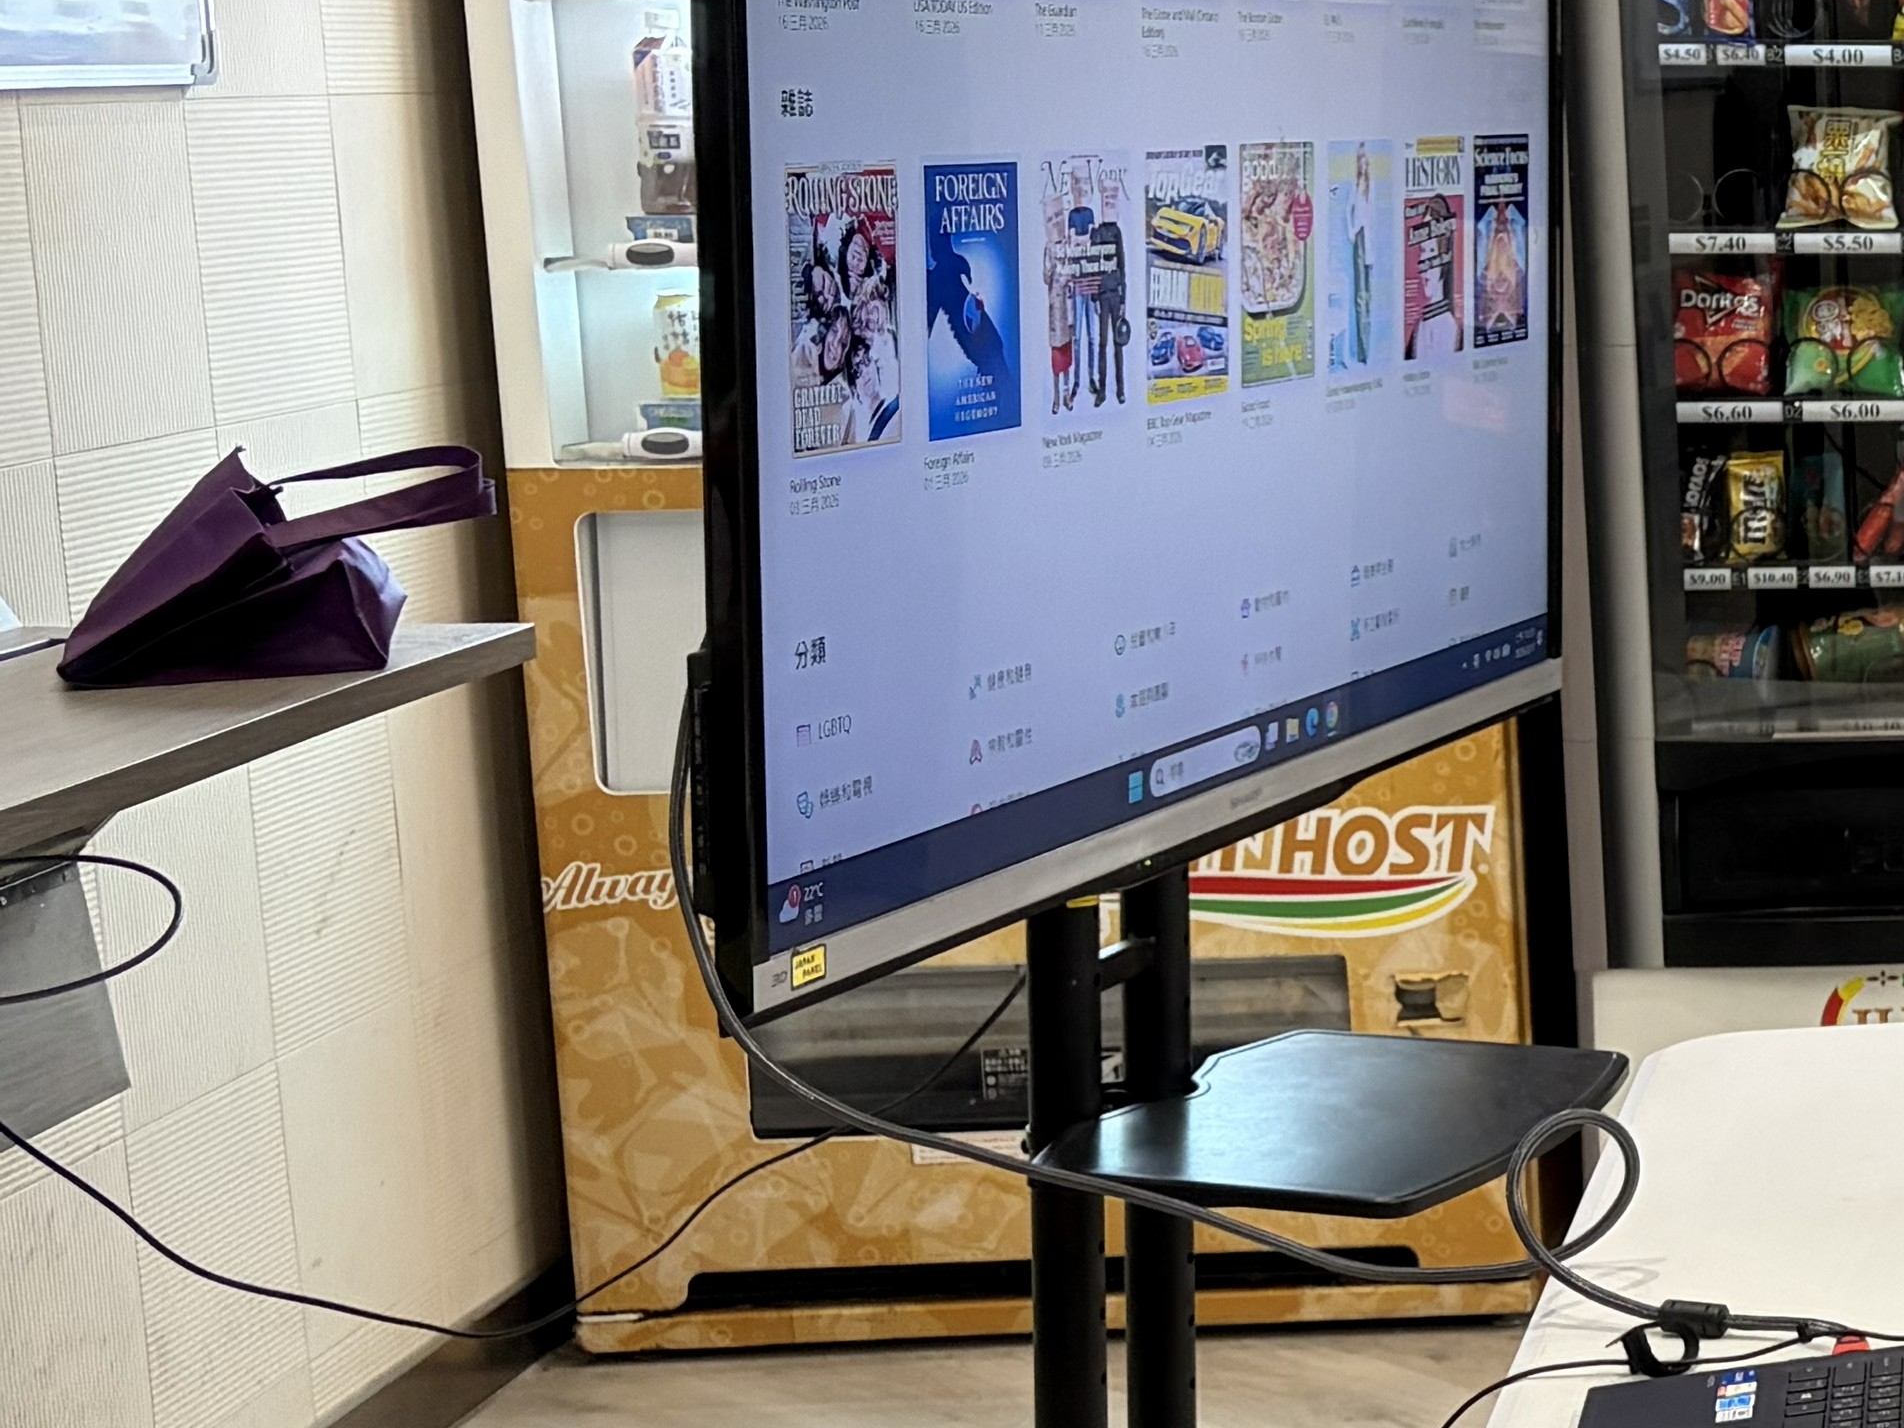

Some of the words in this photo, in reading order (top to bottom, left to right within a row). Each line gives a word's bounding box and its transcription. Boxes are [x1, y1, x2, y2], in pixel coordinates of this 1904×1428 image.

[1663, 48, 1700, 61] $4.50
[1813, 49, 1863, 64] $4.00
[781, 89, 813, 117] 雜誌
[786, 176, 846, 219] ROLLING
[849, 174, 897, 215] STONE
[935, 173, 1008, 203] FOREIGN
[939, 203, 1004, 234] AFFAIRS
[1695, 236, 1746, 252] $7.40
[1823, 236, 1873, 252] $5.50
[1681, 289, 1759, 312] Doritos
[1702, 405, 1752, 421] $6.60
[1830, 403, 1880, 419] $6.00
[1814, 572, 1850, 584] $6.90
[794, 636, 827, 670] 分類
[818, 715, 852, 740] LGBTQ
[541, 861, 680, 913] Alway
